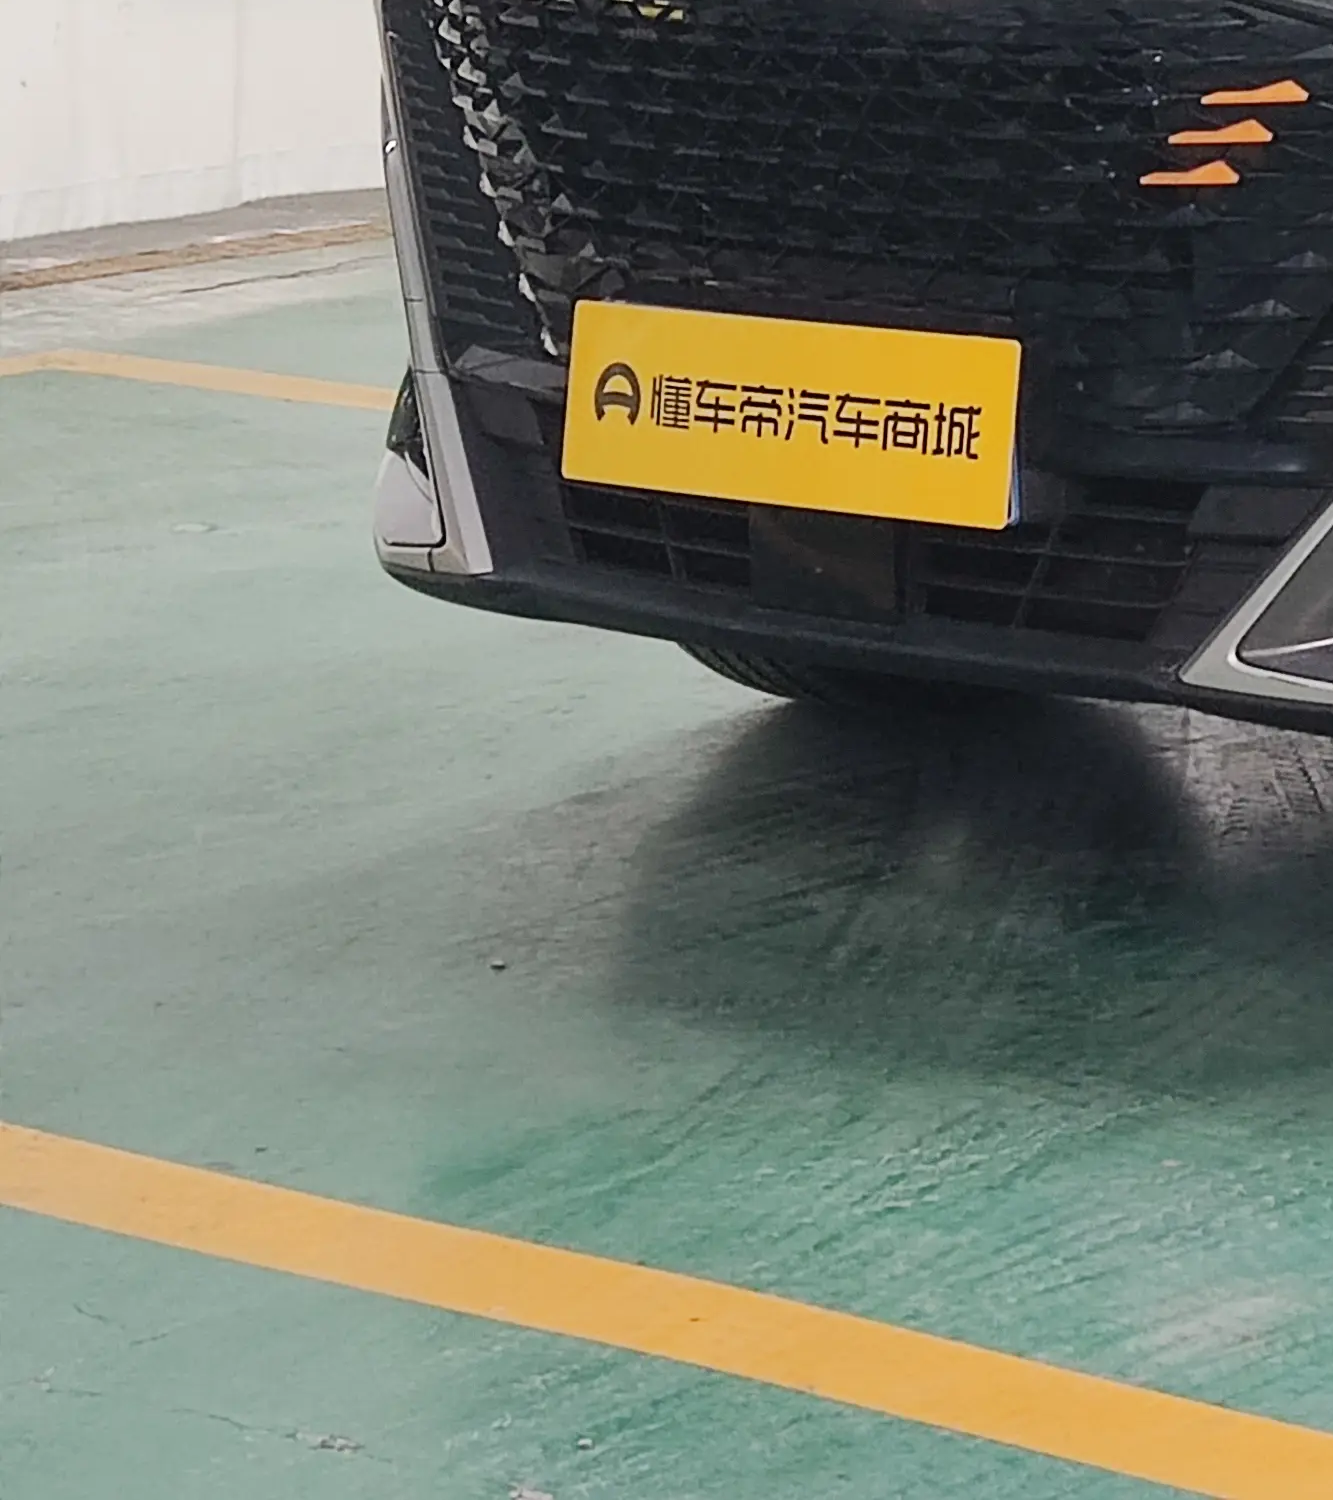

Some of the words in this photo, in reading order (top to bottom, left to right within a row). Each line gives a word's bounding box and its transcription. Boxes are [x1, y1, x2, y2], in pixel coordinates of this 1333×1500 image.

[650, 373, 982, 460] 懂车帝汽车商城
